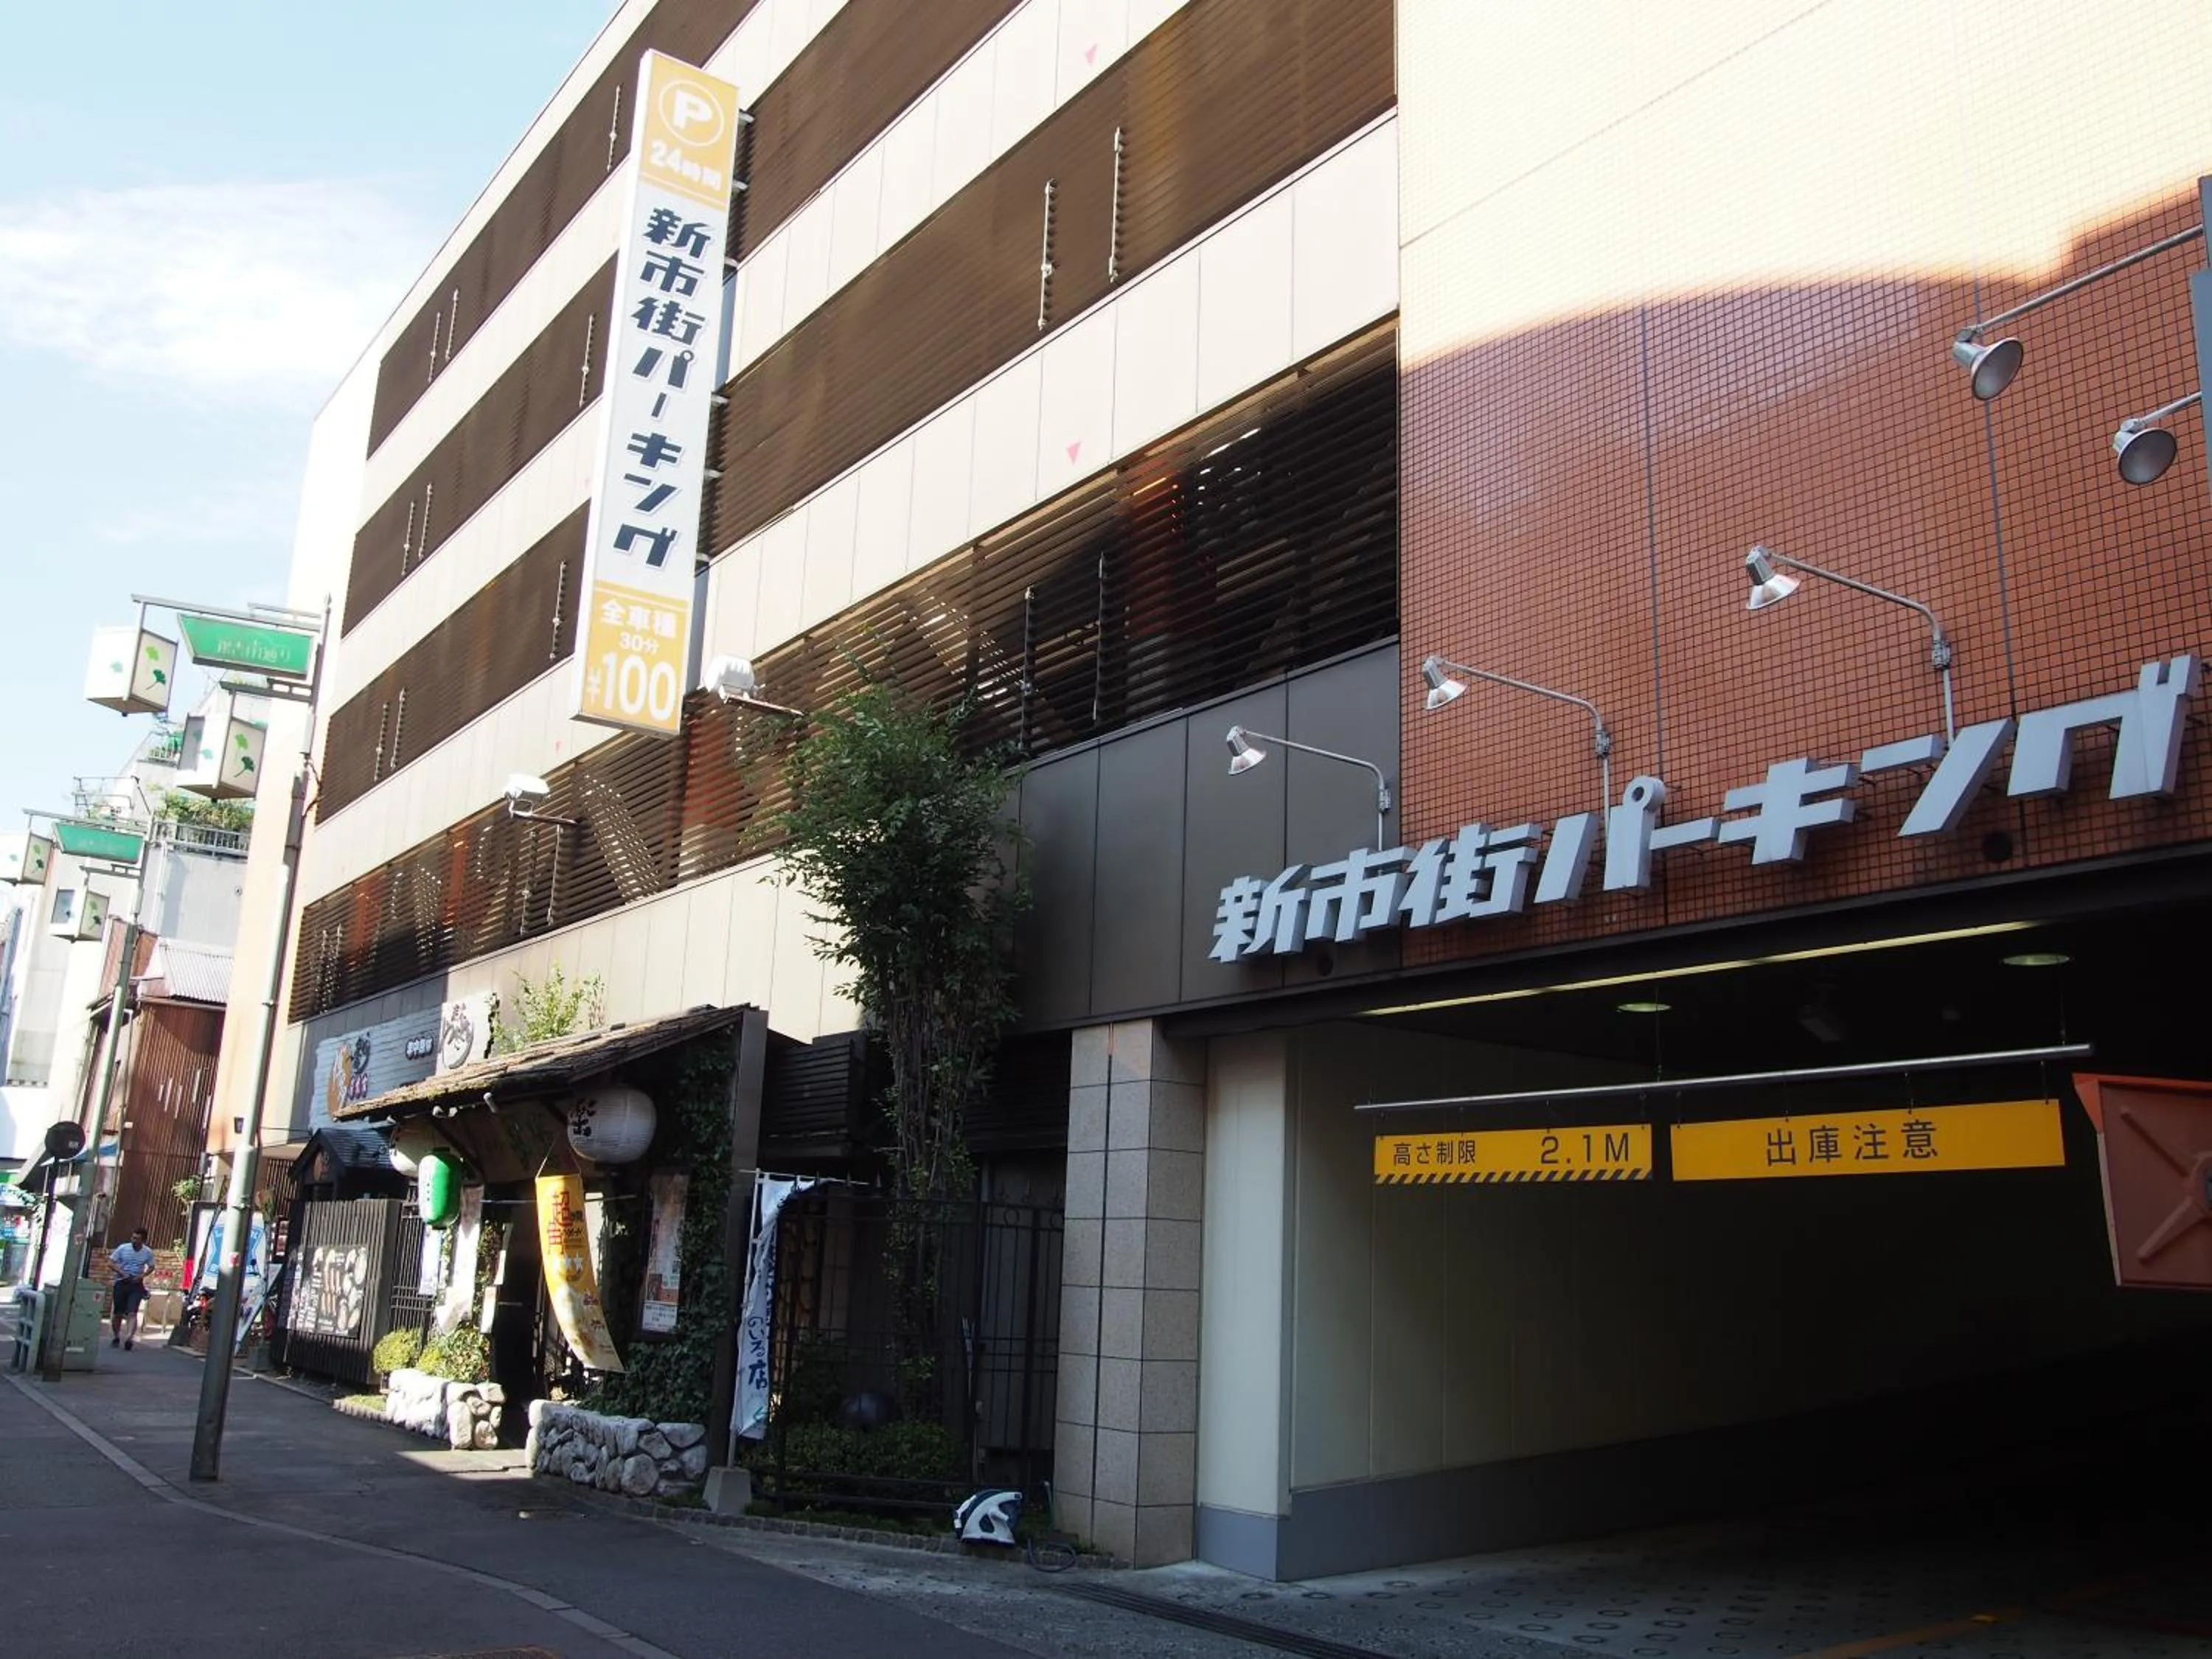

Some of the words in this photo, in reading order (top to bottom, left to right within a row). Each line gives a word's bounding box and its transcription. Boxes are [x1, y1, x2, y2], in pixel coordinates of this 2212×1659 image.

[672, 89, 712, 129] P
[613, 206, 712, 568] 新市街パーキング
[619, 631, 660, 655] 30分
[587, 652, 677, 721] ¥100
[1208, 653, 2201, 964] 新市街パーキング
[1392, 1139, 1475, 1168] 高さ制限
[1540, 1133, 1631, 1166] 2.1M
[1765, 1119, 1940, 1167] 出庫注意
